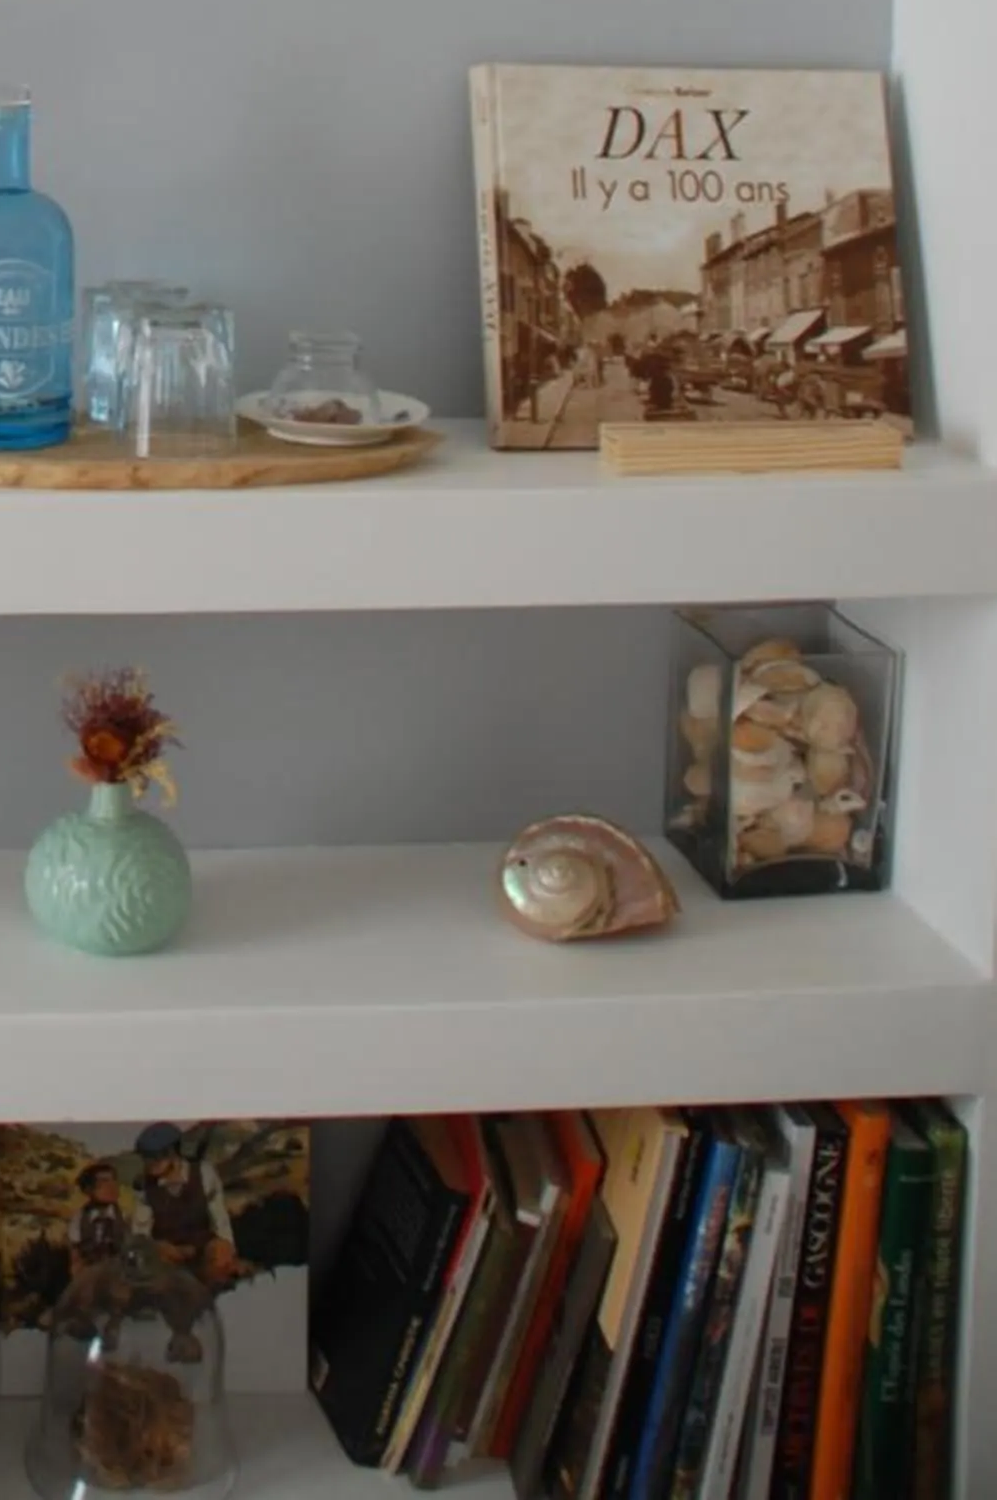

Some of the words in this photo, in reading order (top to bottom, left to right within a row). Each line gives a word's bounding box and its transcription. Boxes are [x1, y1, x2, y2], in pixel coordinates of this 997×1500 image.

[595, 106, 750, 161] DAX
[571, 166, 587, 200] Il
[597, 180, 618, 211] y
[628, 180, 651, 201] a
[667, 169, 724, 202] 100
[735, 181, 791, 203] ans
[802, 1136, 843, 1289] GASCOGNE
